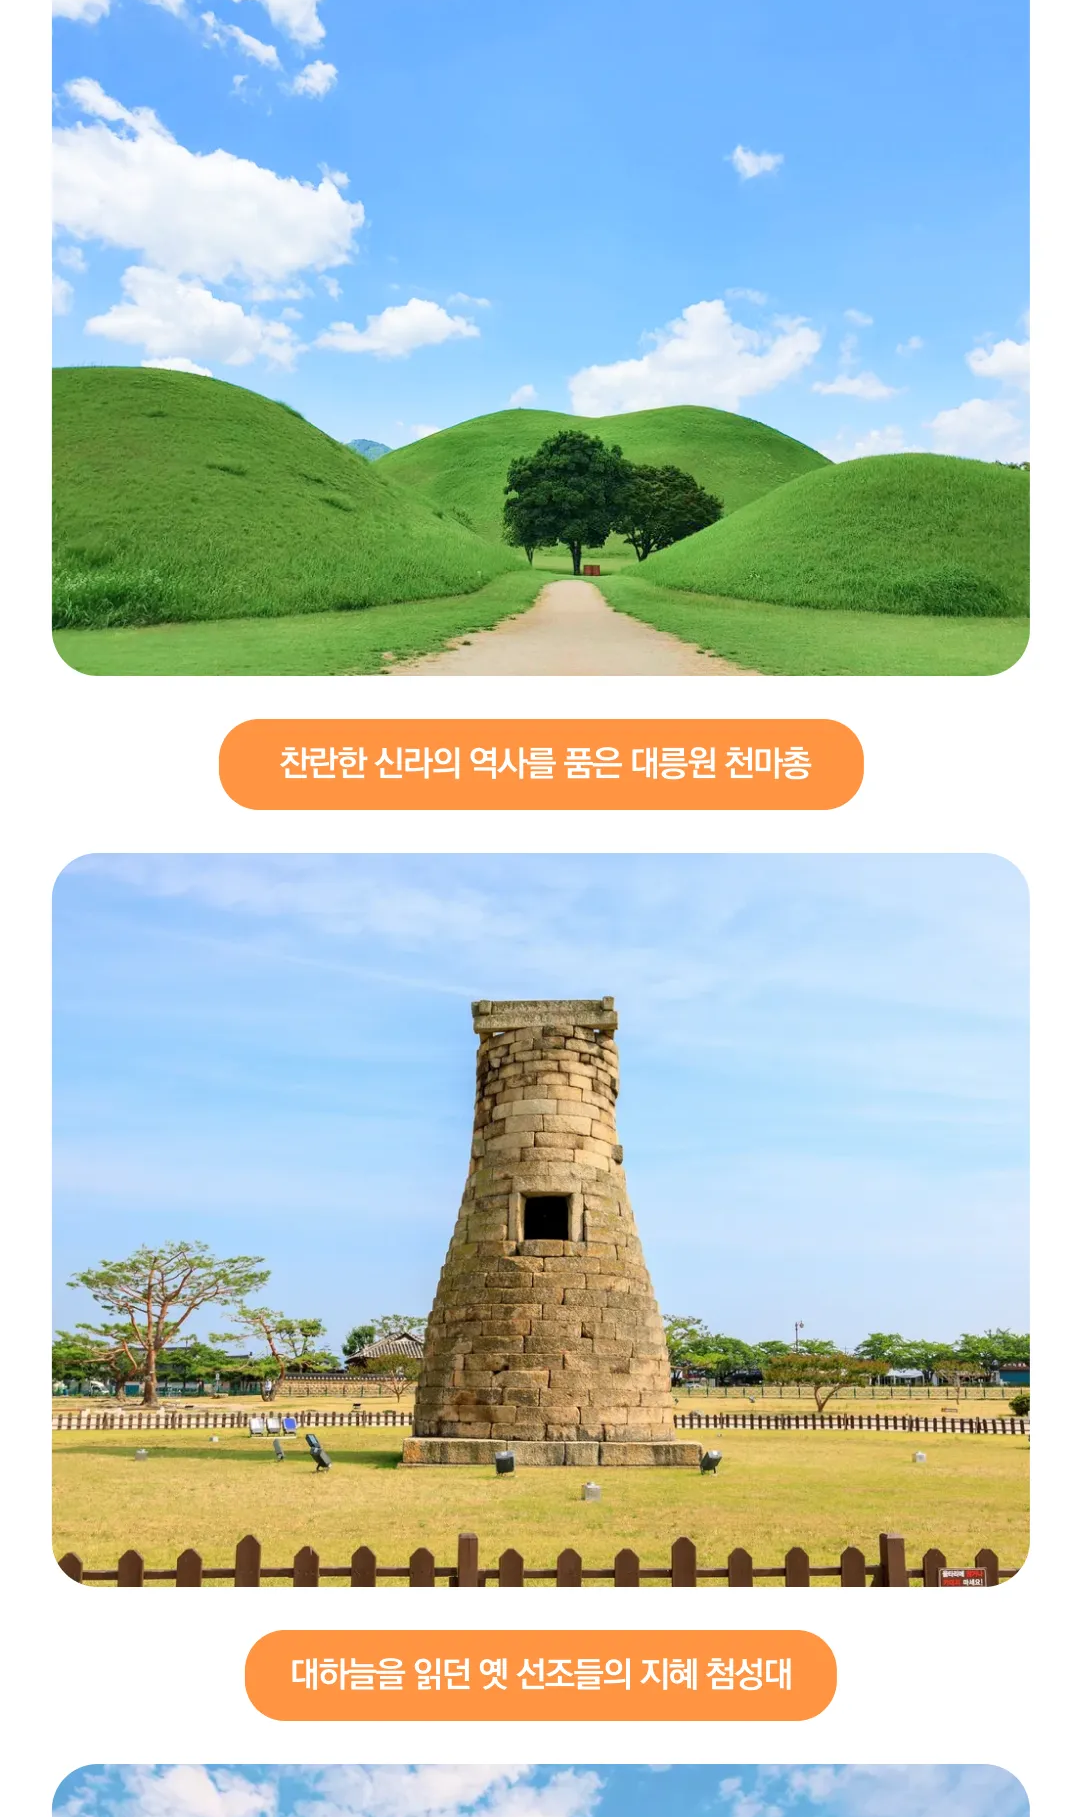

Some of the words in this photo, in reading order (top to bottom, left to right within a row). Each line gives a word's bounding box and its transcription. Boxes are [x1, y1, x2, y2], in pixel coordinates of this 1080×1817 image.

[963, 1578, 984, 1586] 마세요!
[292, 1658, 405, 1690] 대하늘을
[415, 1658, 470, 1690] 읽던
[480, 1658, 507, 1690] 옛
[516, 1658, 630, 1690] 선조들의
[640, 1658, 697, 1690] 지혜
[706, 1658, 791, 1690] 첨성대
